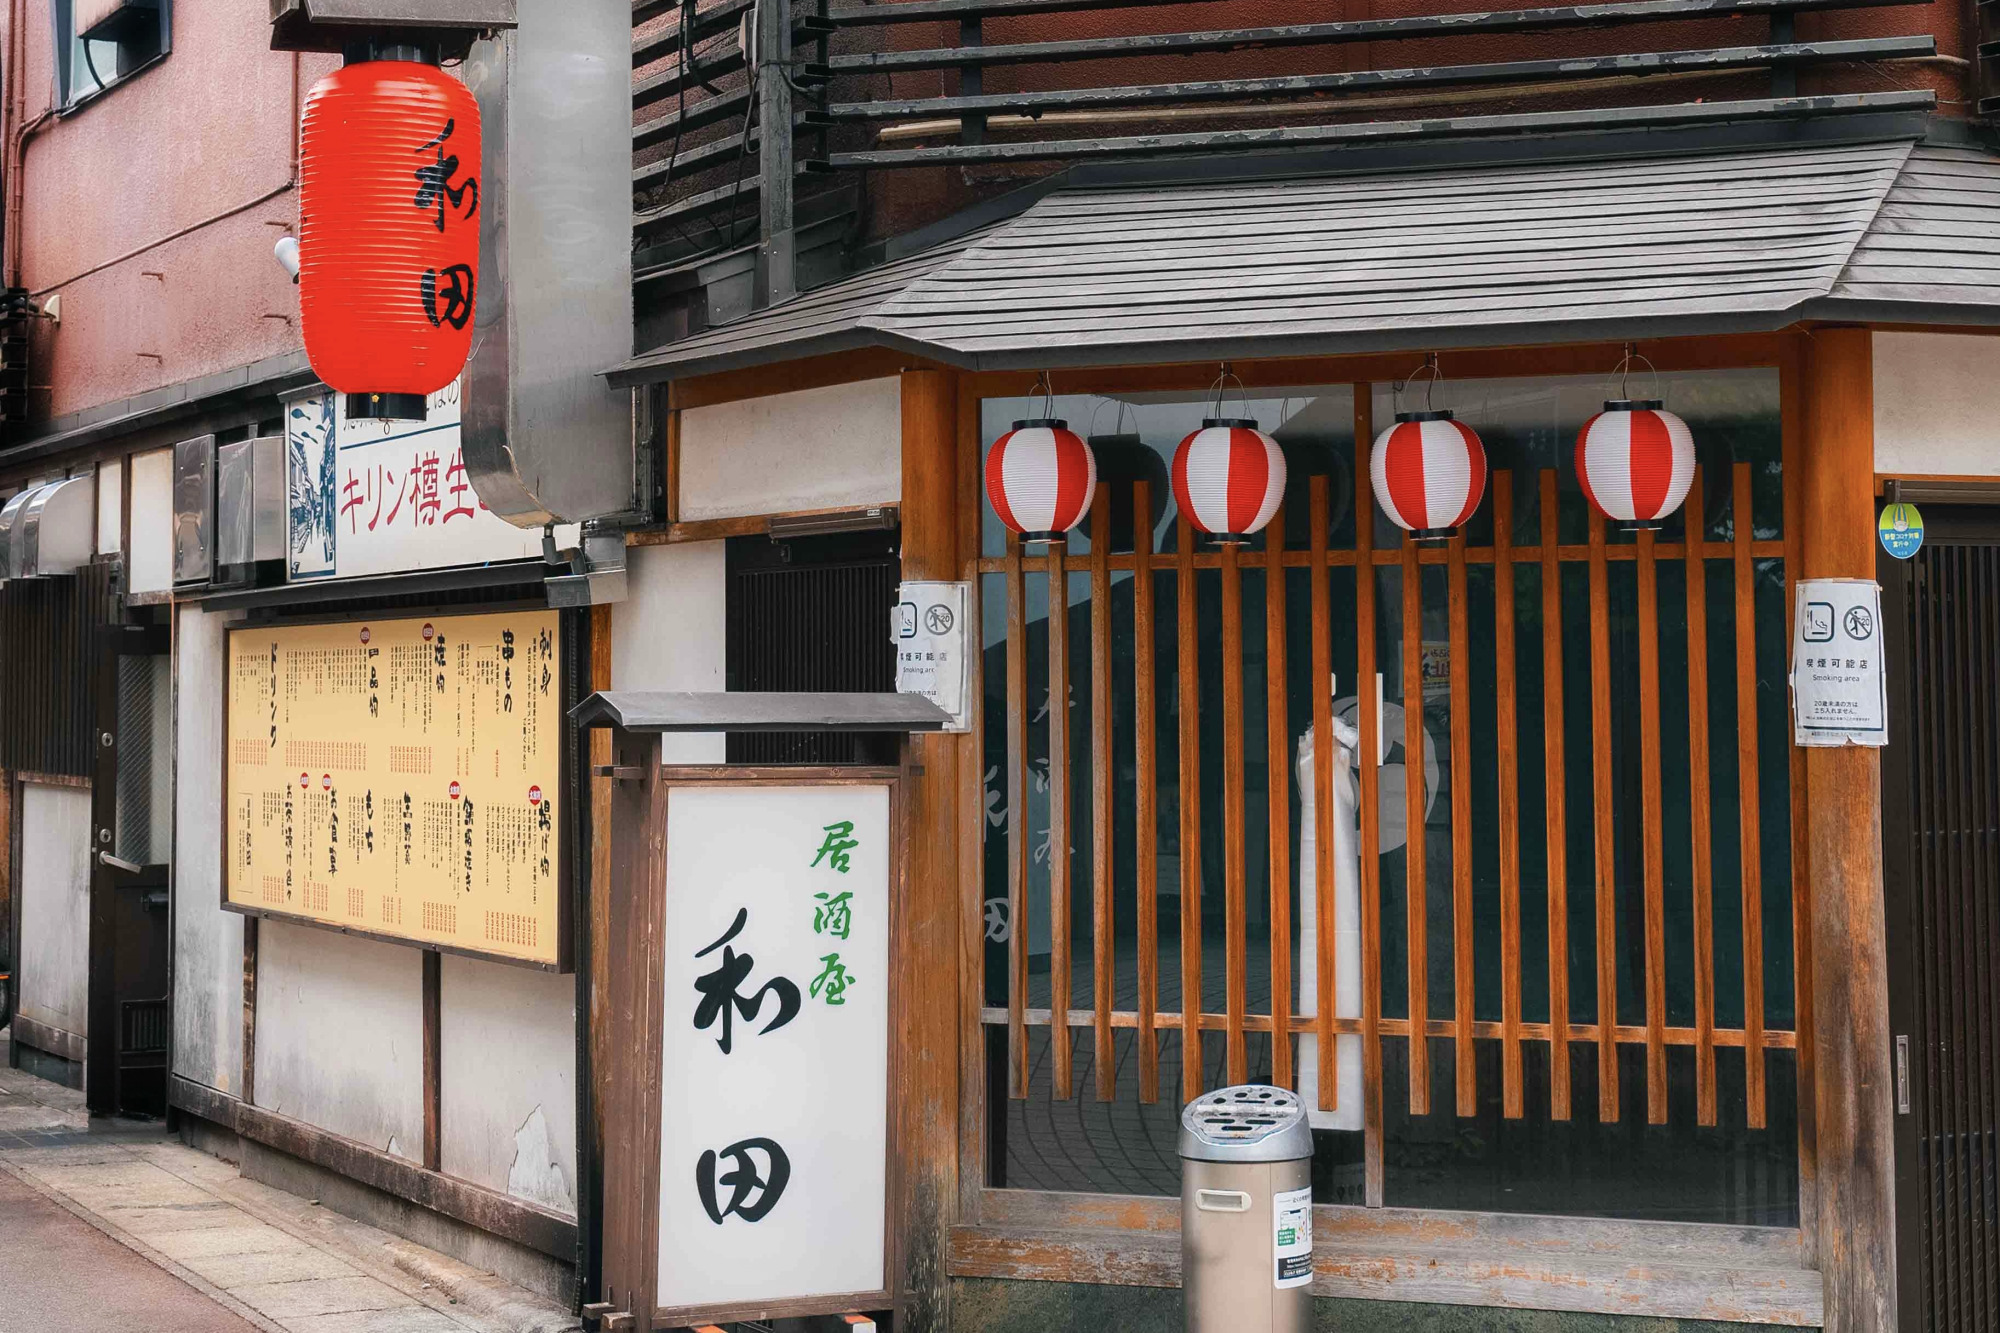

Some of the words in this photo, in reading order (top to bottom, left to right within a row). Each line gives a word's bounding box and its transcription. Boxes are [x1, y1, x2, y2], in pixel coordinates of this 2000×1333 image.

[414, 118, 478, 330] 和田
[341, 447, 489, 535] キリン樽生
[270, 641, 278, 749] ドリンク
[502, 628, 515, 713] 串もの
[540, 627, 553, 697] 刺身
[1806, 658, 1868, 669] 喫煙可能店
[1813, 674, 1843, 683] Smoking
[327, 787, 340, 877] お食事
[365, 789, 375, 854] もち
[538, 799, 552, 877] 揚げ物
[809, 821, 859, 1006] 居酒屋
[694, 908, 801, 1225] 和田
